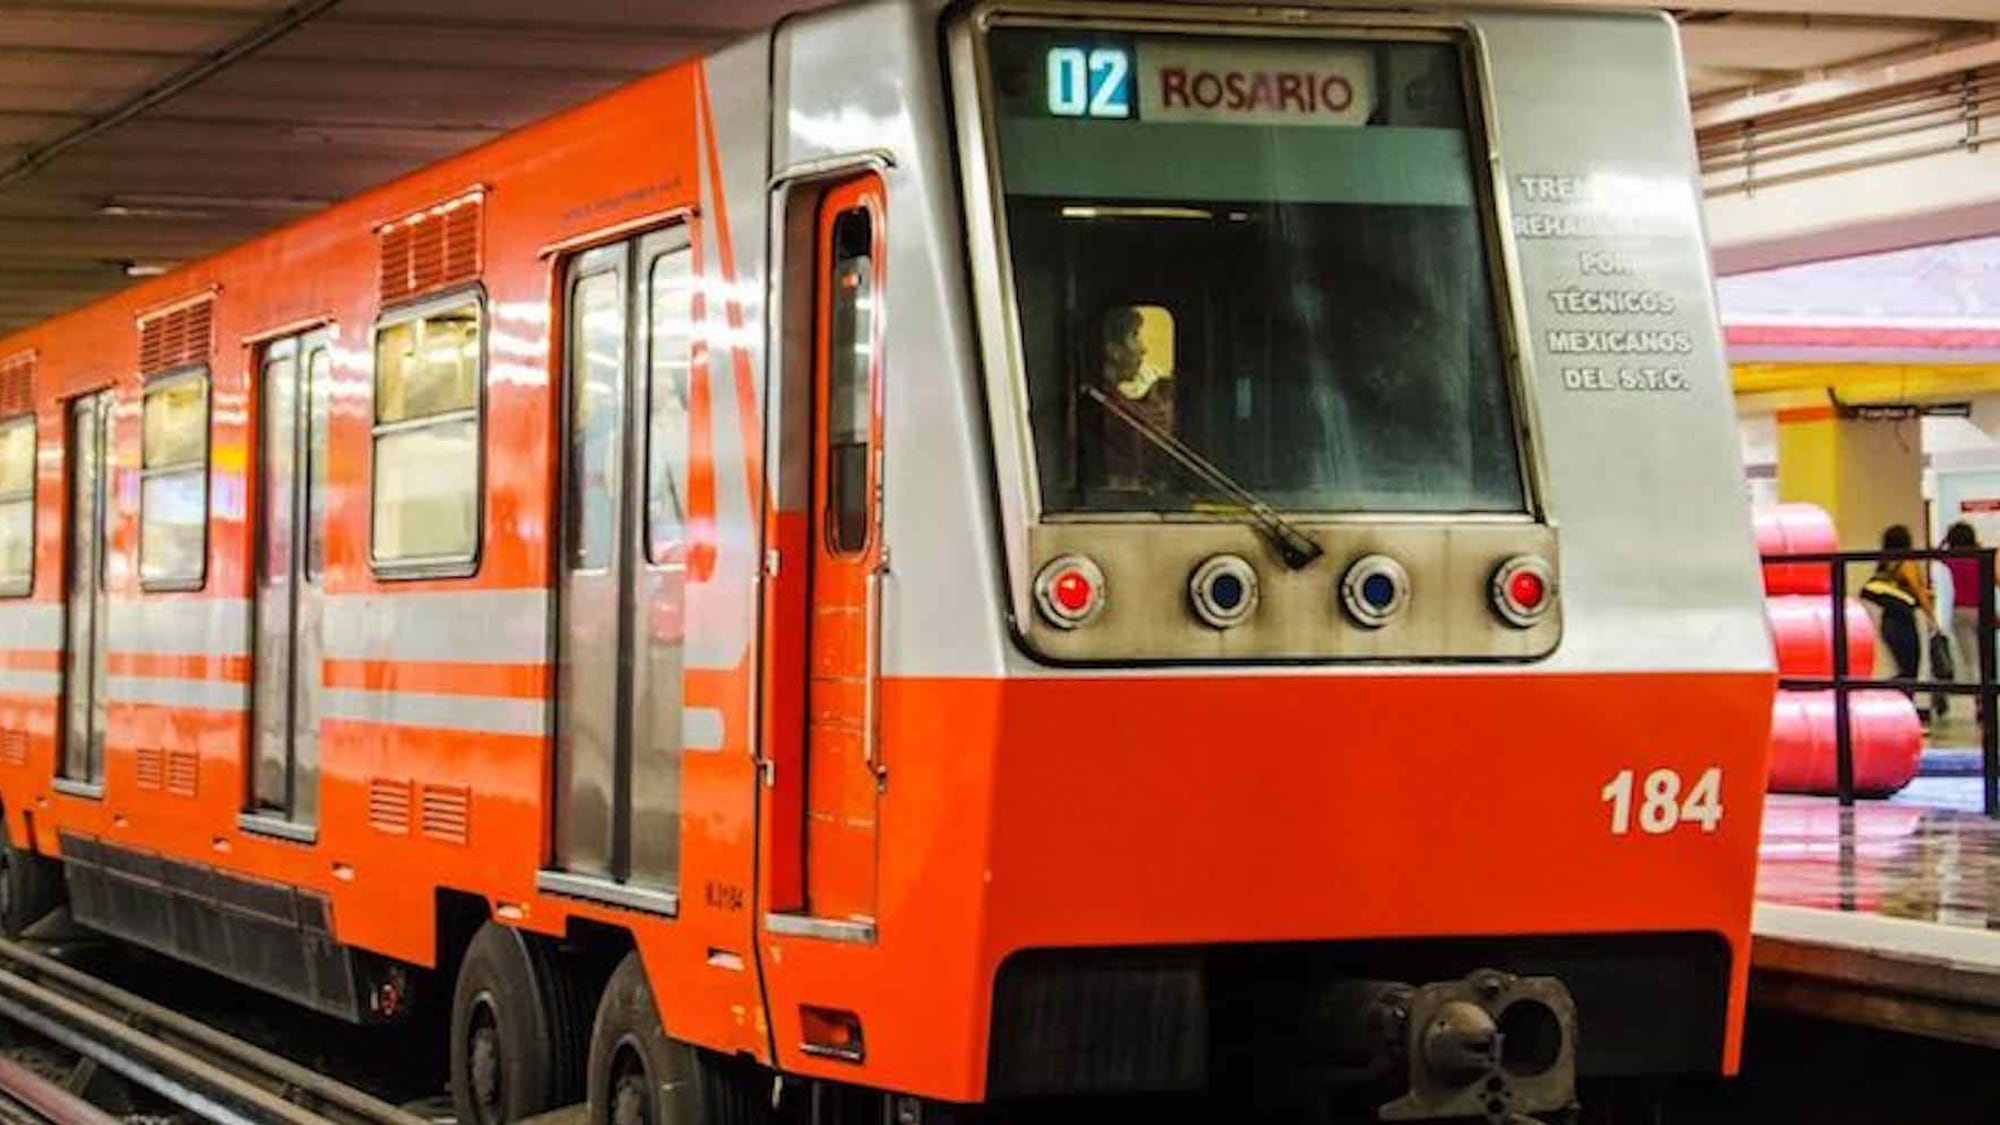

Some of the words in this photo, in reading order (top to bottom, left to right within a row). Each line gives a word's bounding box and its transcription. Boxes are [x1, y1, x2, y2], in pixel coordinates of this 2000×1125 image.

[1047, 47, 1129, 117] 02
[1160, 66, 1353, 113] ROSARIO
[1550, 286, 1674, 313] TÉCNICOS
[1548, 331, 1692, 354] MEXICANOS
[1563, 369, 1614, 389] DEL
[1620, 369, 1690, 390] S.T.C.
[1602, 767, 1723, 834] 184
